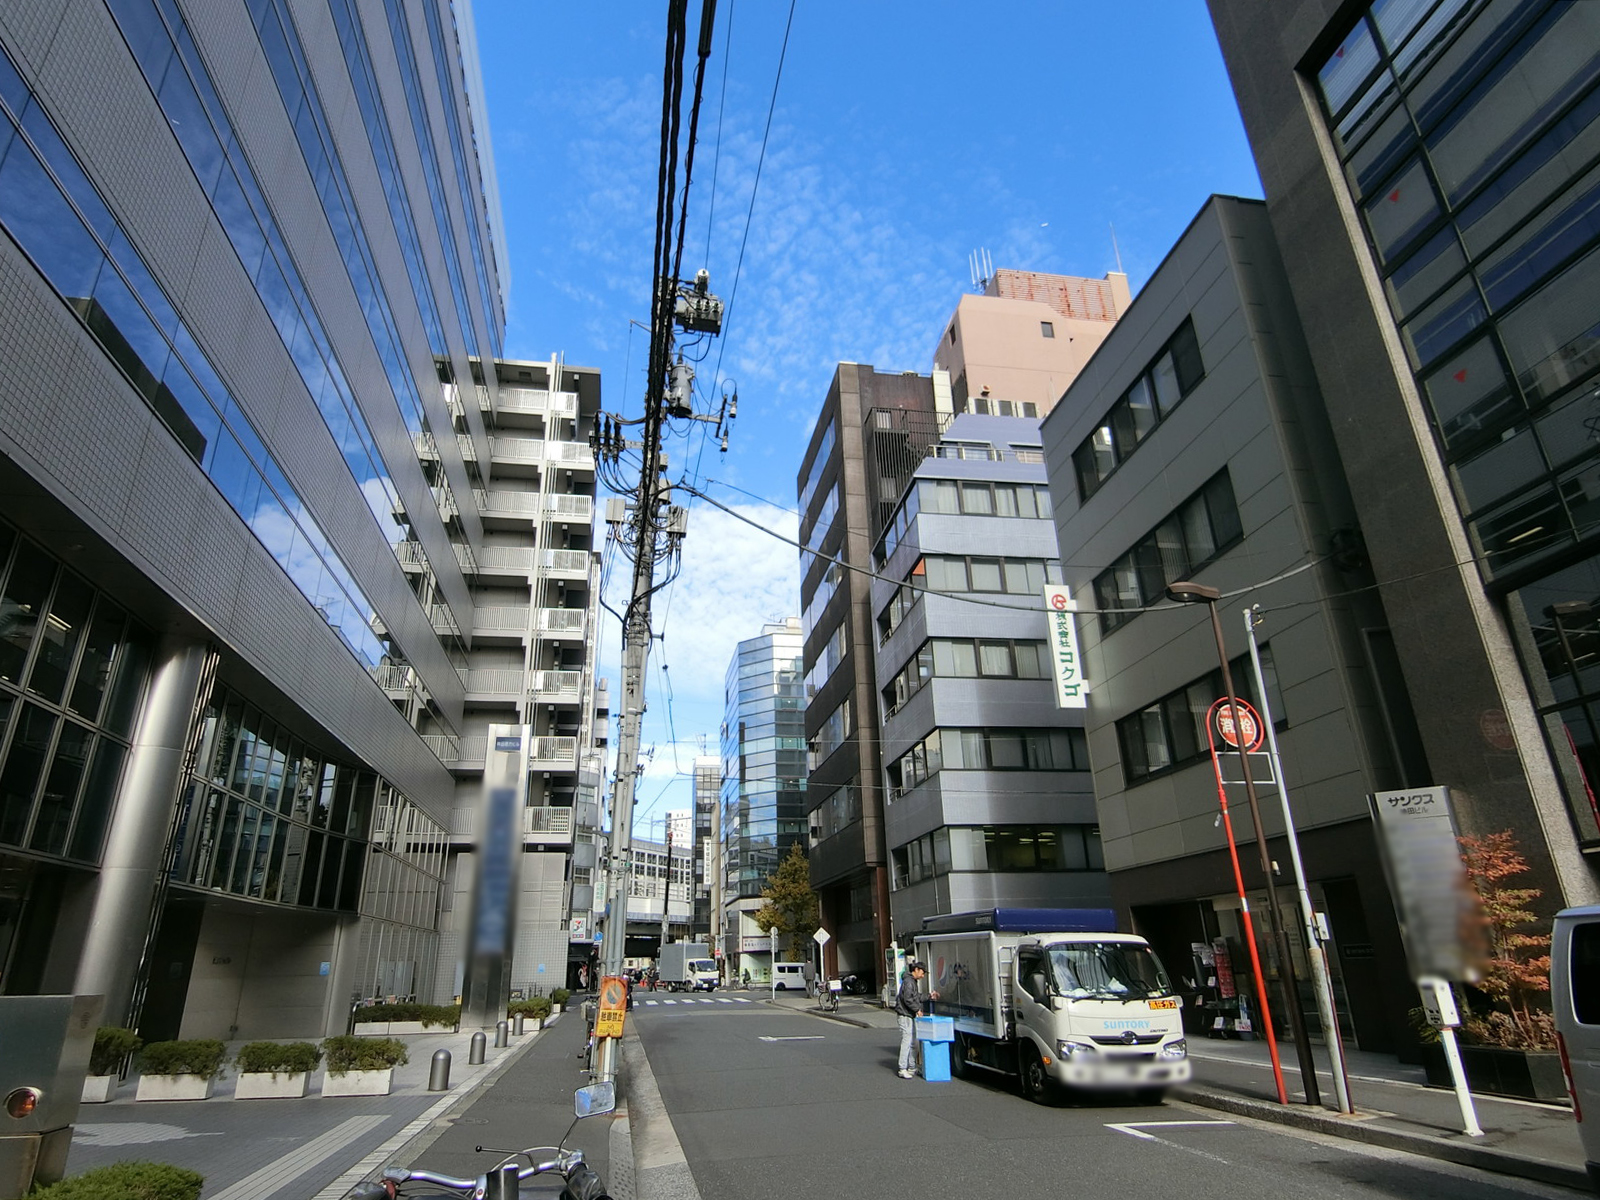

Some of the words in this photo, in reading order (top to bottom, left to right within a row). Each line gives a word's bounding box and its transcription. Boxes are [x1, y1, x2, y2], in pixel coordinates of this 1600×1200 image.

[1219, 717, 1254, 734] 消栓
[1387, 793, 1435, 807] サンクス
[1149, 1000, 1177, 1010] 高圧ガス
[1103, 1020, 1151, 1029] SUNTORY
